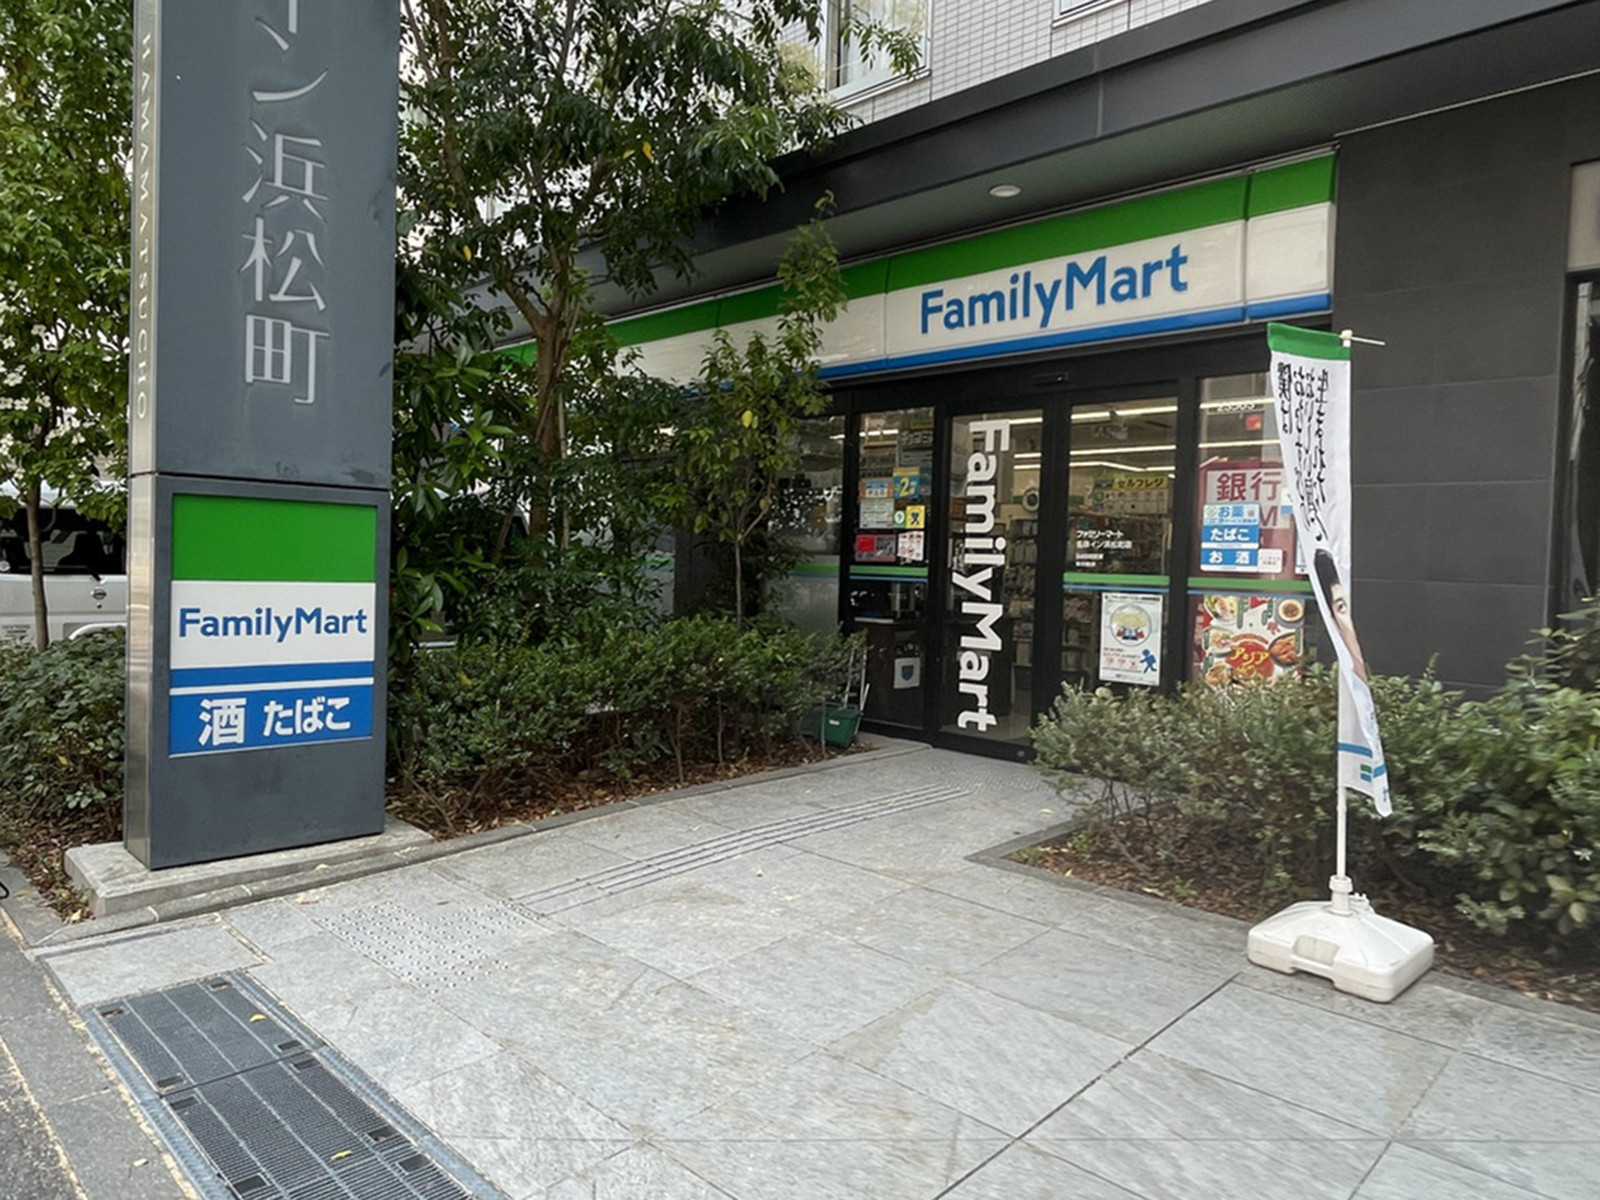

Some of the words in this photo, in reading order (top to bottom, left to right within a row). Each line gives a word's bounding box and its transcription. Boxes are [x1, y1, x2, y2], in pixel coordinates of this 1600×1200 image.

[135, 32, 152, 420] HAMAMATSUCHO
[920, 243, 1189, 335] FamilyMart
[1216, 471, 1282, 501] 銀行
[1210, 528, 1250, 542] たばこ
[950, 418, 1010, 733] FamilyMart
[179, 607, 367, 643] FamilyMart
[198, 697, 247, 747] 酒
[262, 695, 351, 737] たばこ
